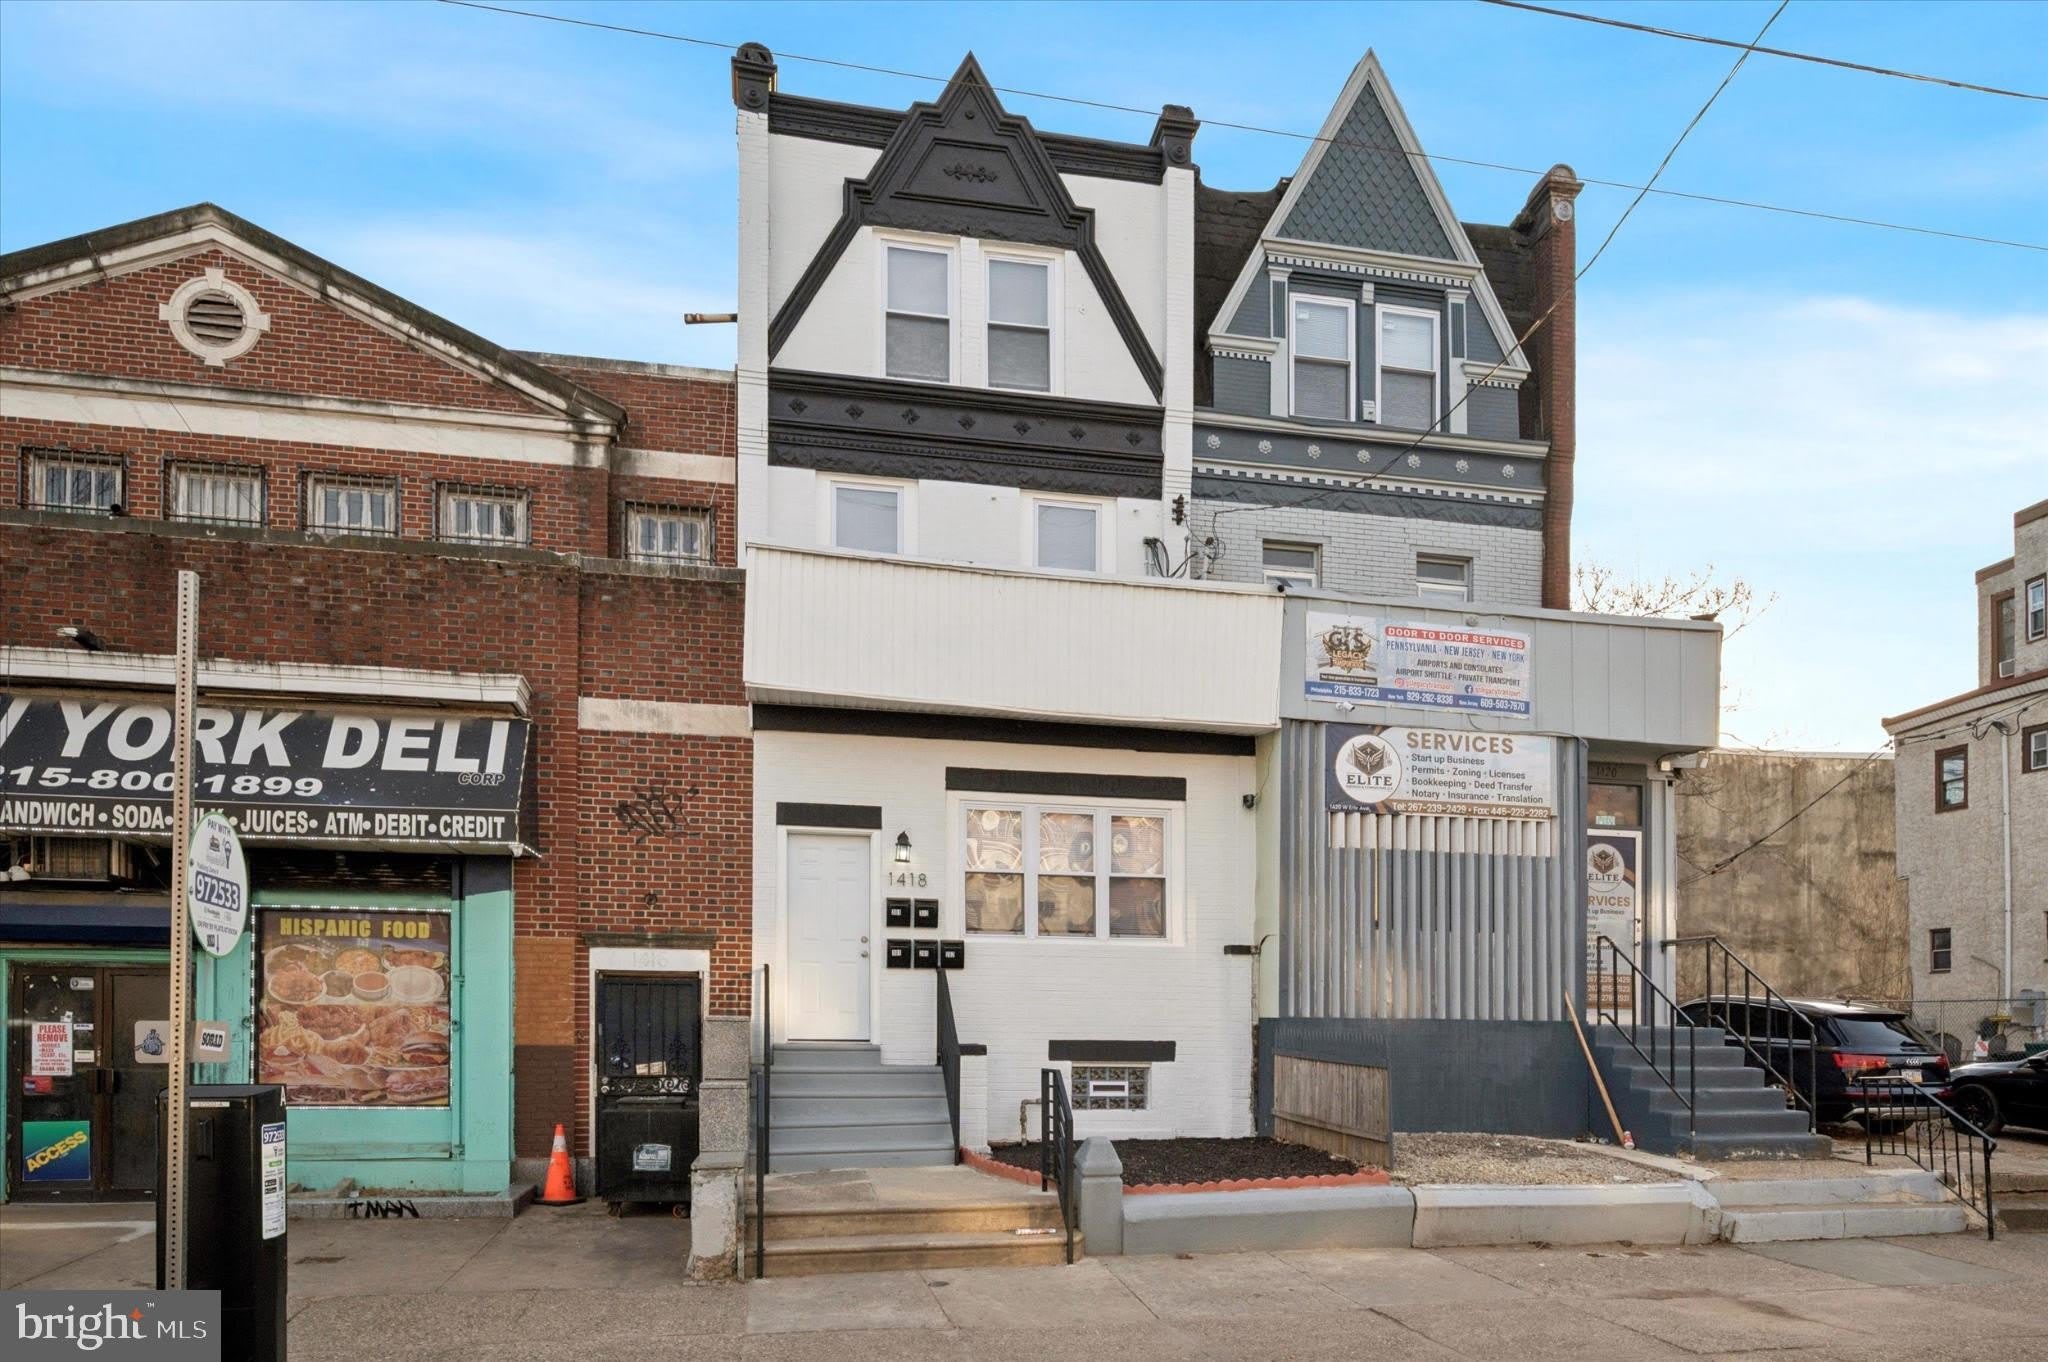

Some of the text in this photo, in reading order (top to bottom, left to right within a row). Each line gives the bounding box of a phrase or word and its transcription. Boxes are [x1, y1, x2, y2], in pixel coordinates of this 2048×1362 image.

[1387, 627, 1524, 649] DOOR TO DOOR SERVICES
[1332, 650, 1363, 659] LEGACY
[1386, 640, 1525, 663] PENNSYLVANIA NEW JERSEY NEW YORK
[1417, 658, 1504, 674] AIRPORTS AND CONSULATES
[1395, 667, 1521, 687] AIRPORT SHUTTLE PRIVATE TRANSPORT
[60, 699, 304, 768] YORK
[322, 714, 510, 774] DELI
[1406, 731, 1514, 755] SERVICES
[1411, 753, 1485, 766] Start up Business
[458, 772, 506, 786] CORP
[1346, 774, 1392, 787] ELITE
[1411, 765, 1526, 780] Permits Zoning Licenses
[1411, 777, 1533, 792] Bookkeeping Deed Transfer
[1411, 789, 1544, 804] Notary Insurance Translation
[112, 804, 165, 829] SODA
[240, 809, 309, 834] JUICES
[324, 812, 364, 836] ATM
[375, 813, 430, 837] DEBIT
[439, 814, 506, 839] CREDIT
[207, 818, 231, 837] PAY WITH
[888, 871, 928, 888] 1418
[1588, 873, 1619, 881] ELITE
[196, 873, 239, 911] 972533
[280, 917, 430, 939] HISPANIC FOOD
[39, 1024, 66, 1034] PLEASE
[37, 1033, 69, 1042] REMOVE
[26, 1131, 88, 1173] ACCESS
